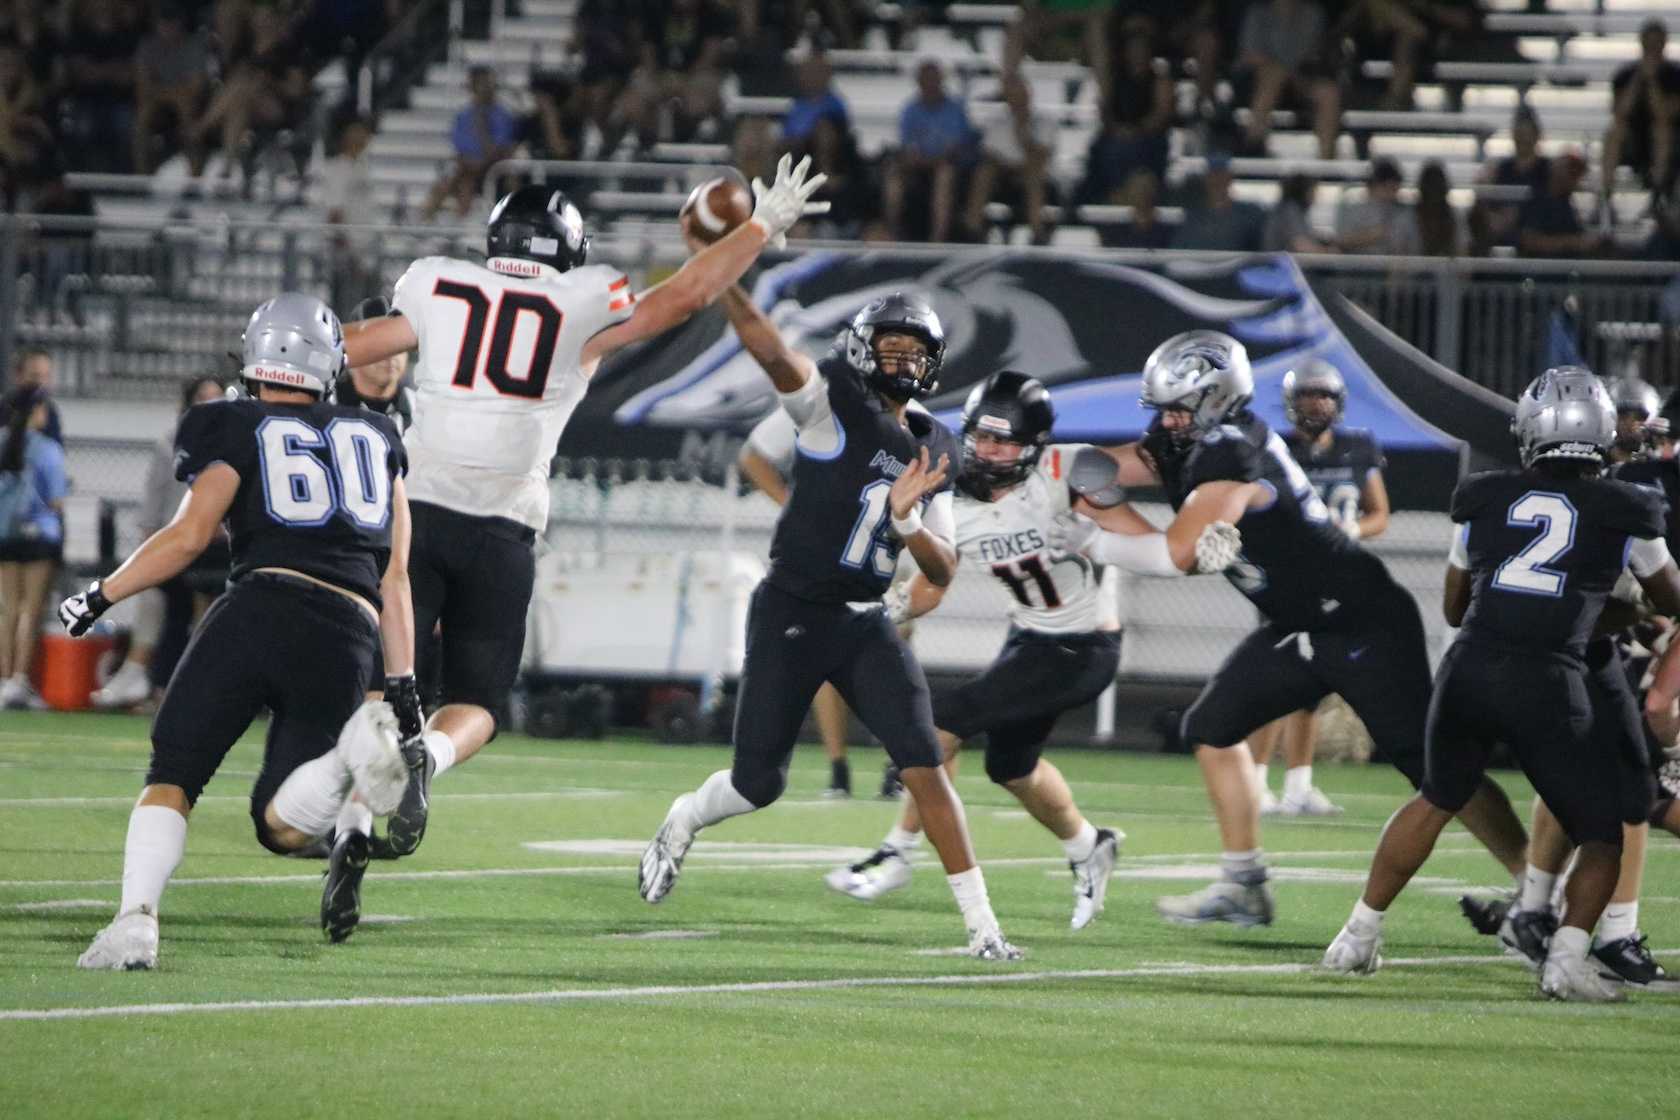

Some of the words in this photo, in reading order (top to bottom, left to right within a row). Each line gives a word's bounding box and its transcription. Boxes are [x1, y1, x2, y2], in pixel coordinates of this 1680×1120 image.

[494, 260, 541, 276] Riddell
[432, 277, 564, 402] 70
[255, 366, 305, 384] Riddell
[254, 415, 392, 529] 60
[979, 528, 1045, 561] FOXES
[1490, 489, 1579, 598] 2
[991, 553, 1063, 609] 11
